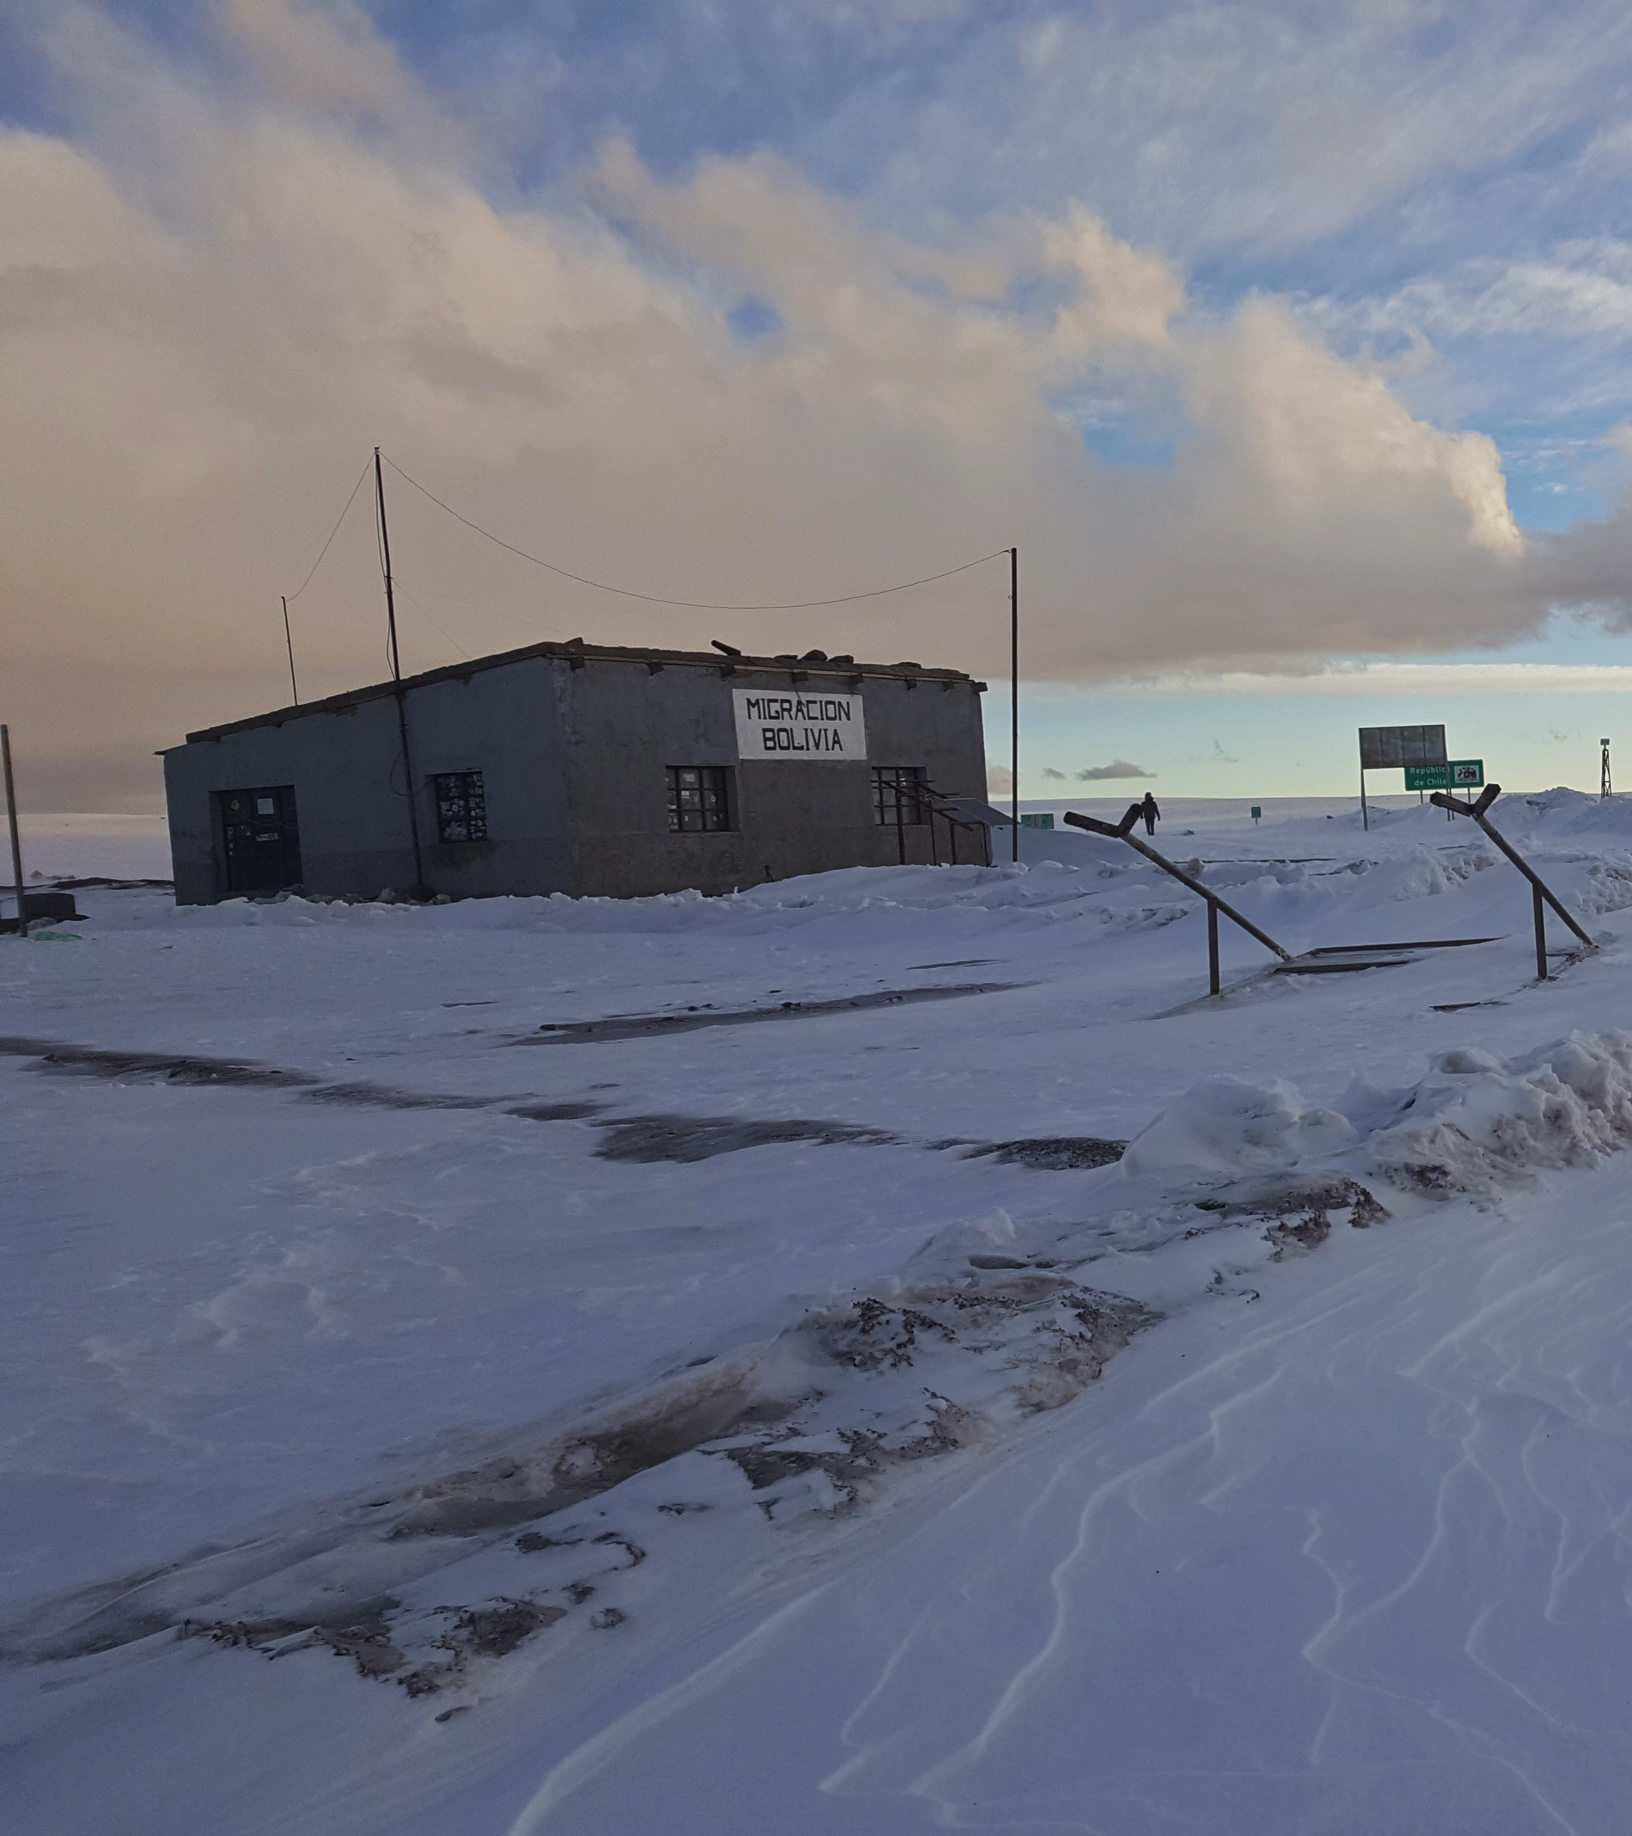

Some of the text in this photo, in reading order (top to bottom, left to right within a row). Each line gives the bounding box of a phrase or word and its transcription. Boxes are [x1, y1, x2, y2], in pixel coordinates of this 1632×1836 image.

[746, 697, 852, 722] MIGRACION
[762, 727, 843, 752] BOLIVIA
[1410, 765, 1450, 775] Repúblic
[1426, 778, 1447, 786] Chile
